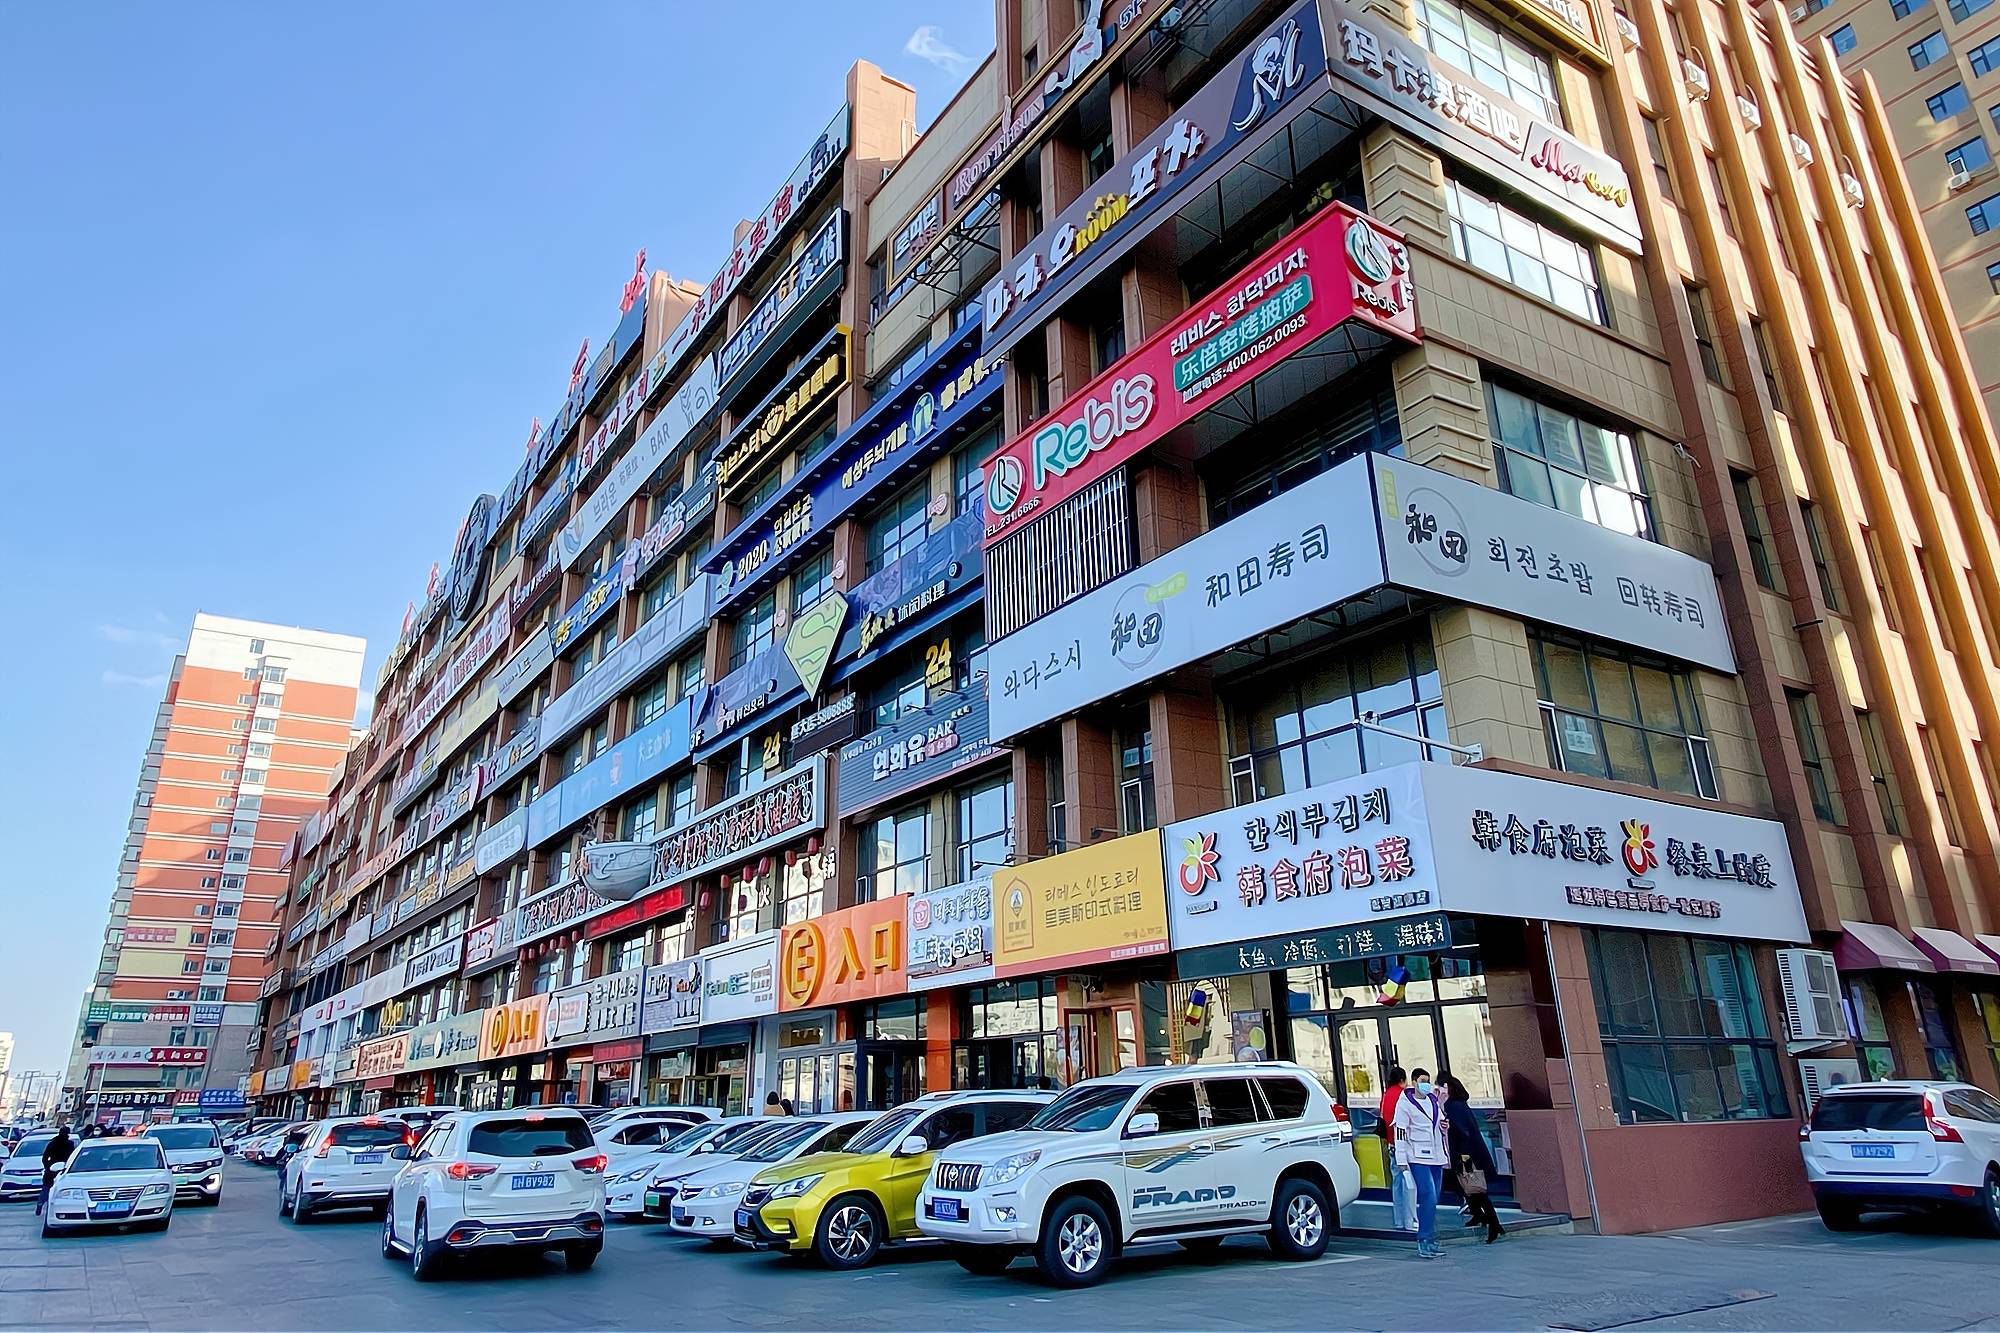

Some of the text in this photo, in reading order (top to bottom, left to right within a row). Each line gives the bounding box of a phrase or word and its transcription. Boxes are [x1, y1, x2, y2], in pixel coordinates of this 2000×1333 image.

[1170, 247, 1310, 358] 레비스 화덕피자
[1180, 280, 1305, 386] 乐倍窑烤披萨
[1032, 373, 1156, 492] Rebis
[737, 539, 768, 582] 2020
[1205, 522, 1331, 609] 和田寿司
[1487, 536, 1594, 597] 회전초밥
[1616, 576, 1706, 630] 回转寿司
[926, 638, 951, 677] 24
[1002, 640, 1083, 701] 와다스시
[928, 719, 953, 744] BAR
[1243, 786, 1392, 853] 한식부김치
[1471, 808, 1615, 866] 韩食府泡菜
[1236, 835, 1415, 908] 韩食府泡菜
[835, 918, 903, 985] 入口
[1132, 1185, 1237, 1210] PRADO
[1219, 1200, 1257, 1210] PRADO
